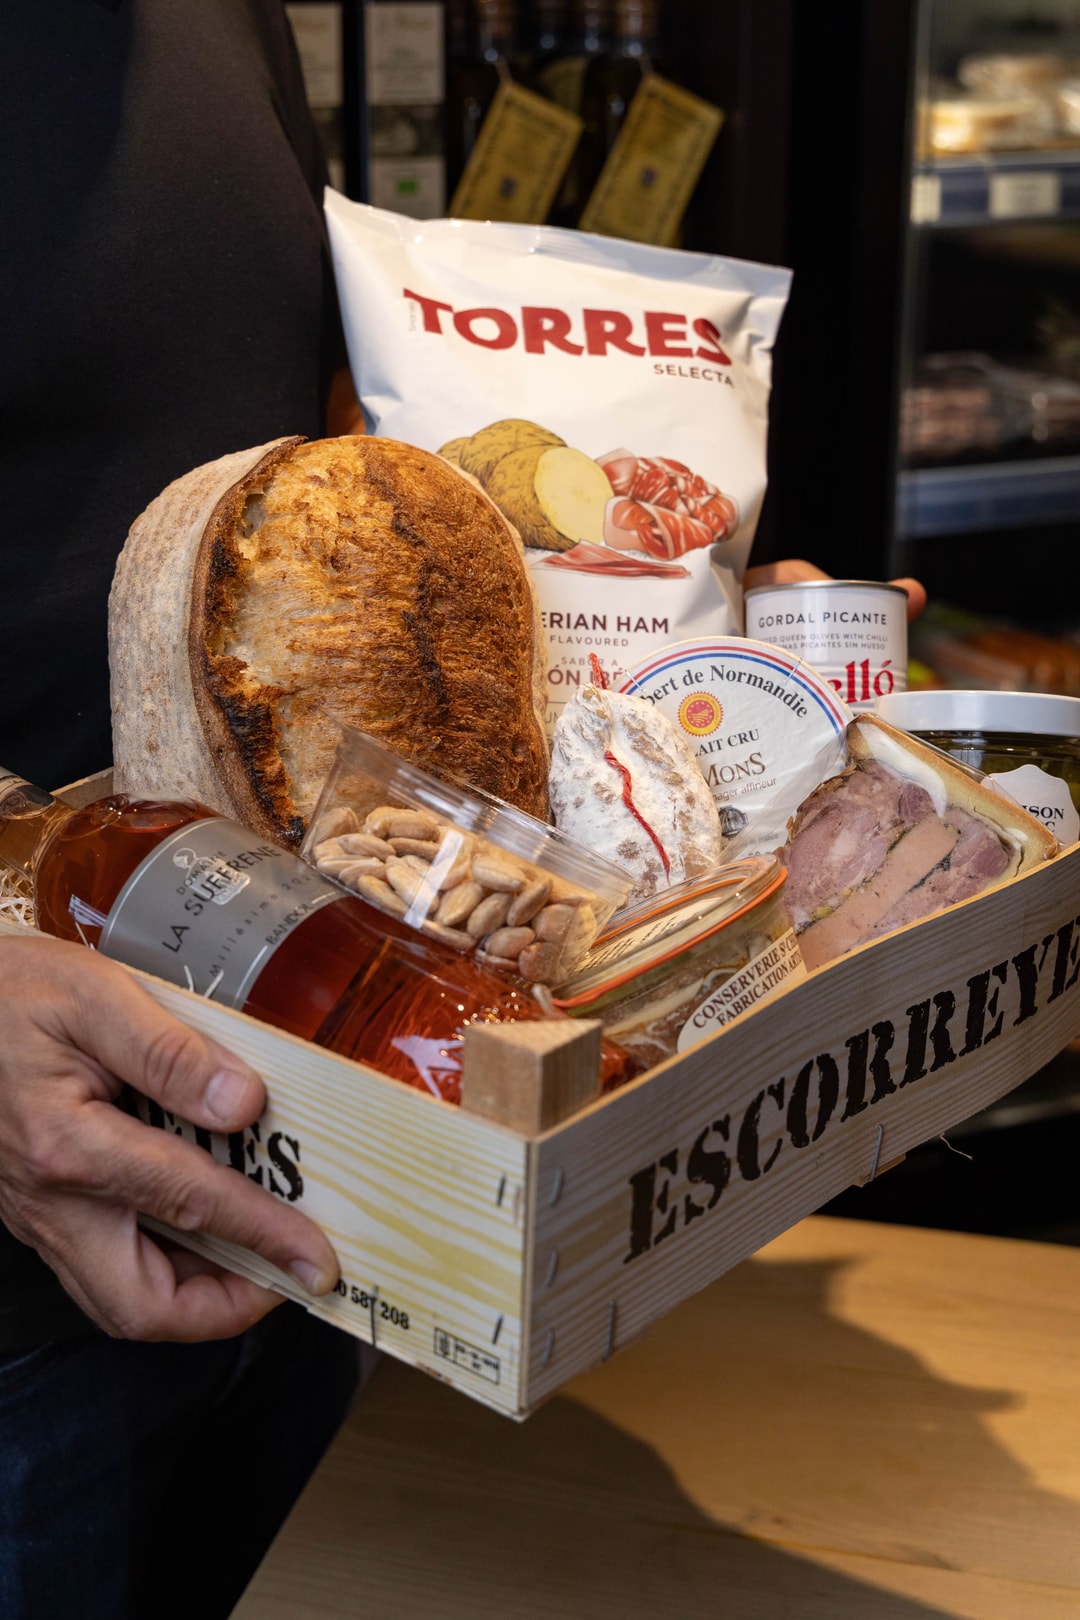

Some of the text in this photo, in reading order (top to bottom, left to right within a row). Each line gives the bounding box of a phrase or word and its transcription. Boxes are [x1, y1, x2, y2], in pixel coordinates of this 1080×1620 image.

[403, 288, 733, 366] TORRES
[654, 364, 735, 388] SELECTA
[617, 616, 669, 635] HAM
[758, 611, 887, 628] GORDAL PICANTE
[549, 634, 630, 648] FLAVOURED
[779, 634, 807, 643] QUEEN
[809, 633, 840, 641] OLIVES
[843, 633, 864, 641] WITH
[800, 641, 841, 650] PICANTES
[844, 641, 859, 649] SIN
[861, 642, 886, 651] HUESO
[610, 658, 619, 667] A
[682, 668, 705, 689] de
[710, 664, 808, 719] Normandie
[695, 729, 760, 757] AIT CRU
[740, 777, 777, 795] affineur
[176, 850, 227, 896] DOMAINE
[162, 845, 282, 954] LA SUFFRENE
[692, 948, 781, 1030] CONSERVERIE
[716, 963, 789, 1028] FABRICATION
[380, 1300, 411, 1330] 208
